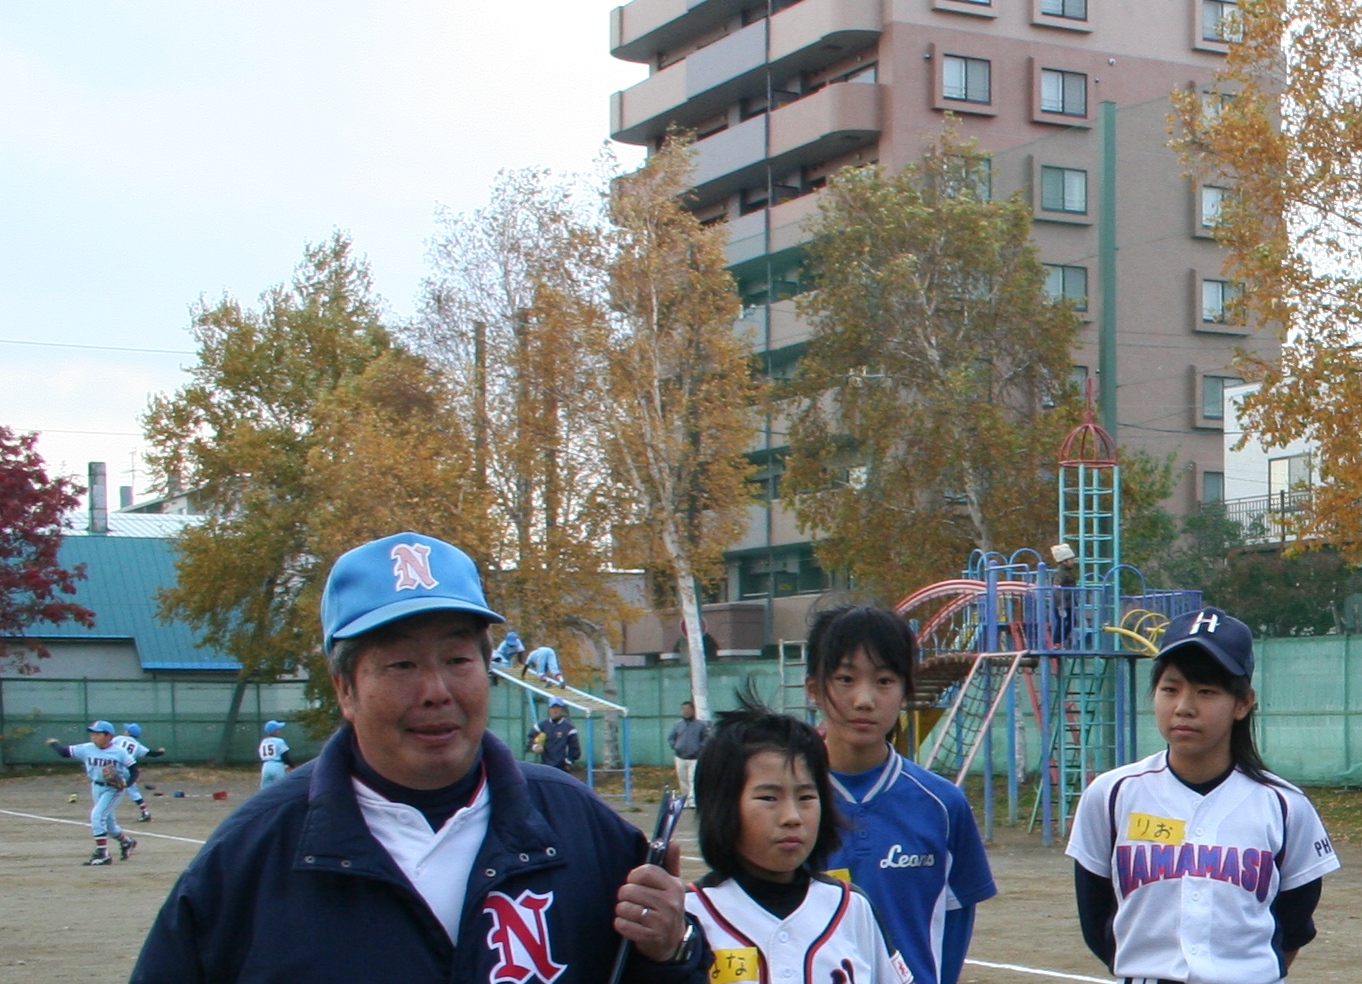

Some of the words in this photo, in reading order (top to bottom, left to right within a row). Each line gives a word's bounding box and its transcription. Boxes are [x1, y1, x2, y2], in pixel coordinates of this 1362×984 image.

[391, 543, 439, 591] N
[1189, 611, 1221, 635] H
[262, 744, 275, 757] 15
[1136, 819, 1173, 840] りお
